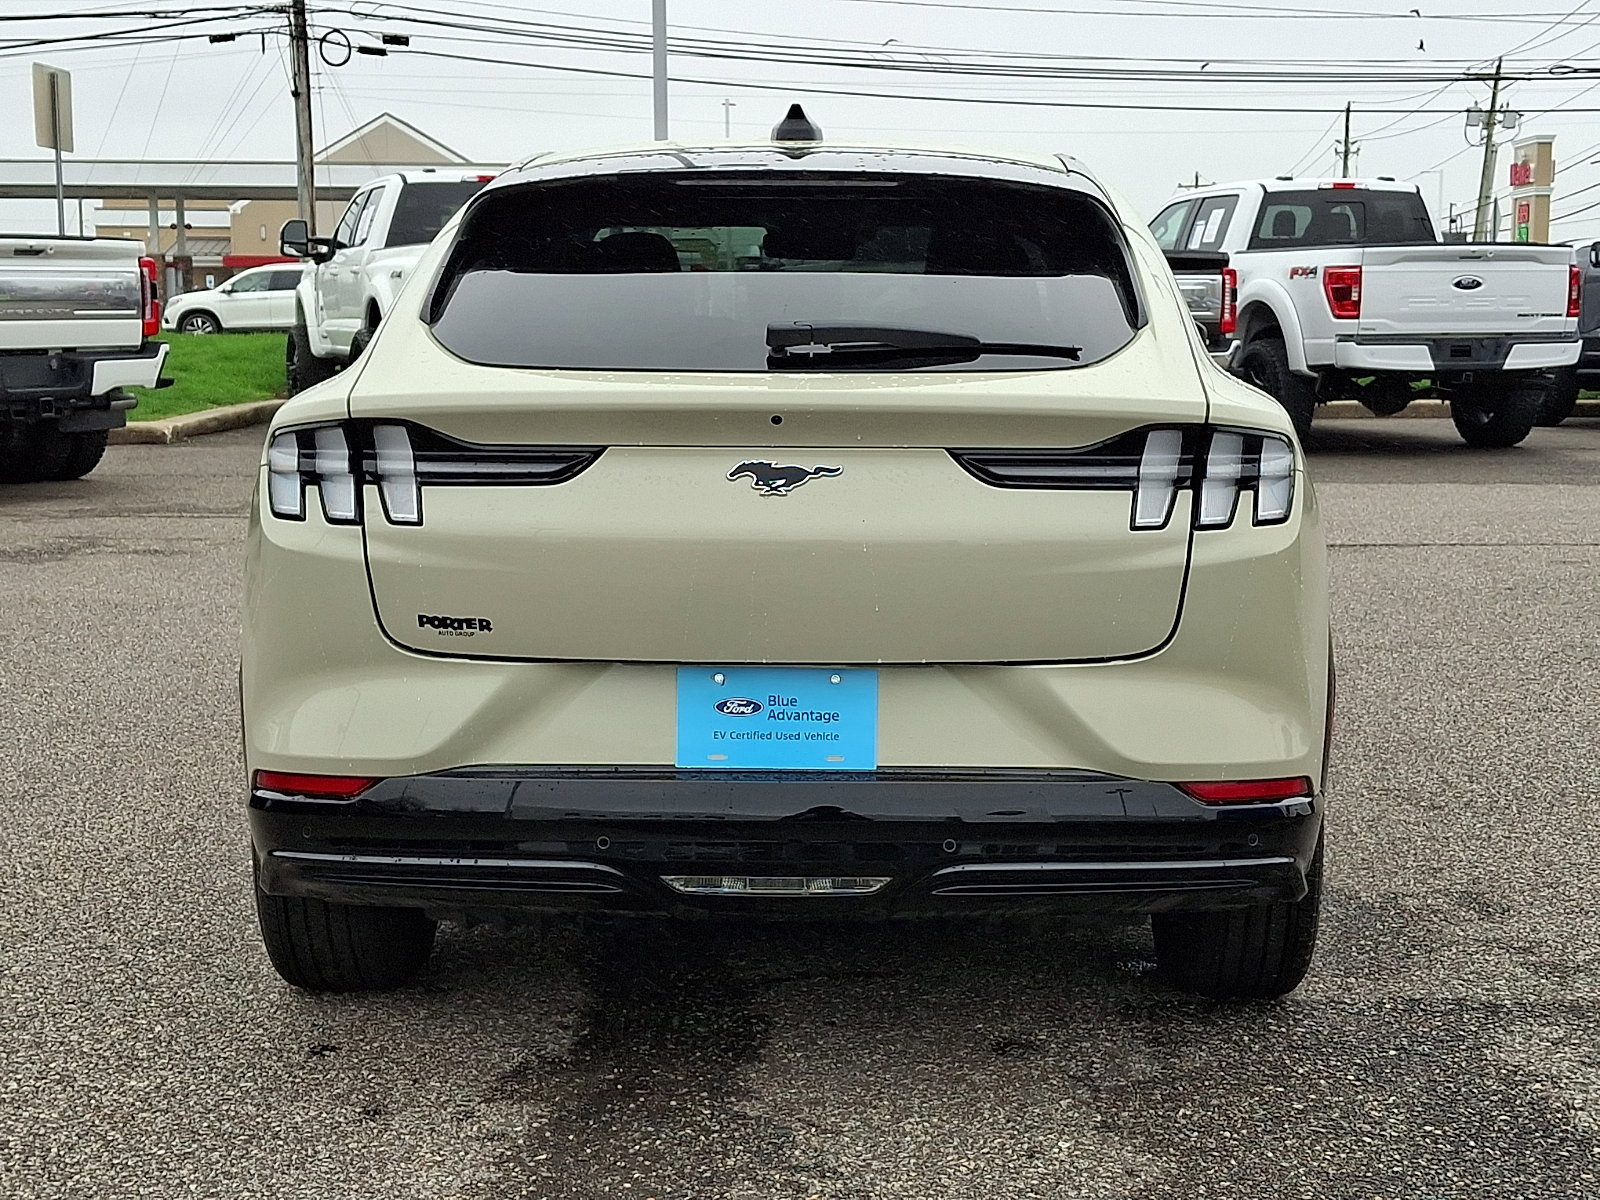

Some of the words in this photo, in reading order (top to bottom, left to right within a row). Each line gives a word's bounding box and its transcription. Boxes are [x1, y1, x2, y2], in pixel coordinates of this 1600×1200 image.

[1289, 265, 1318, 280] FX4
[417, 614, 493, 632] PORTER
[723, 699, 755, 715] Ford
[768, 694, 798, 707] Blue
[767, 709, 840, 724] Advantage
[713, 731, 727, 740] EV
[729, 730, 772, 740] Certified
[775, 731, 801, 741] Used
[804, 731, 840, 741] Vehicle
